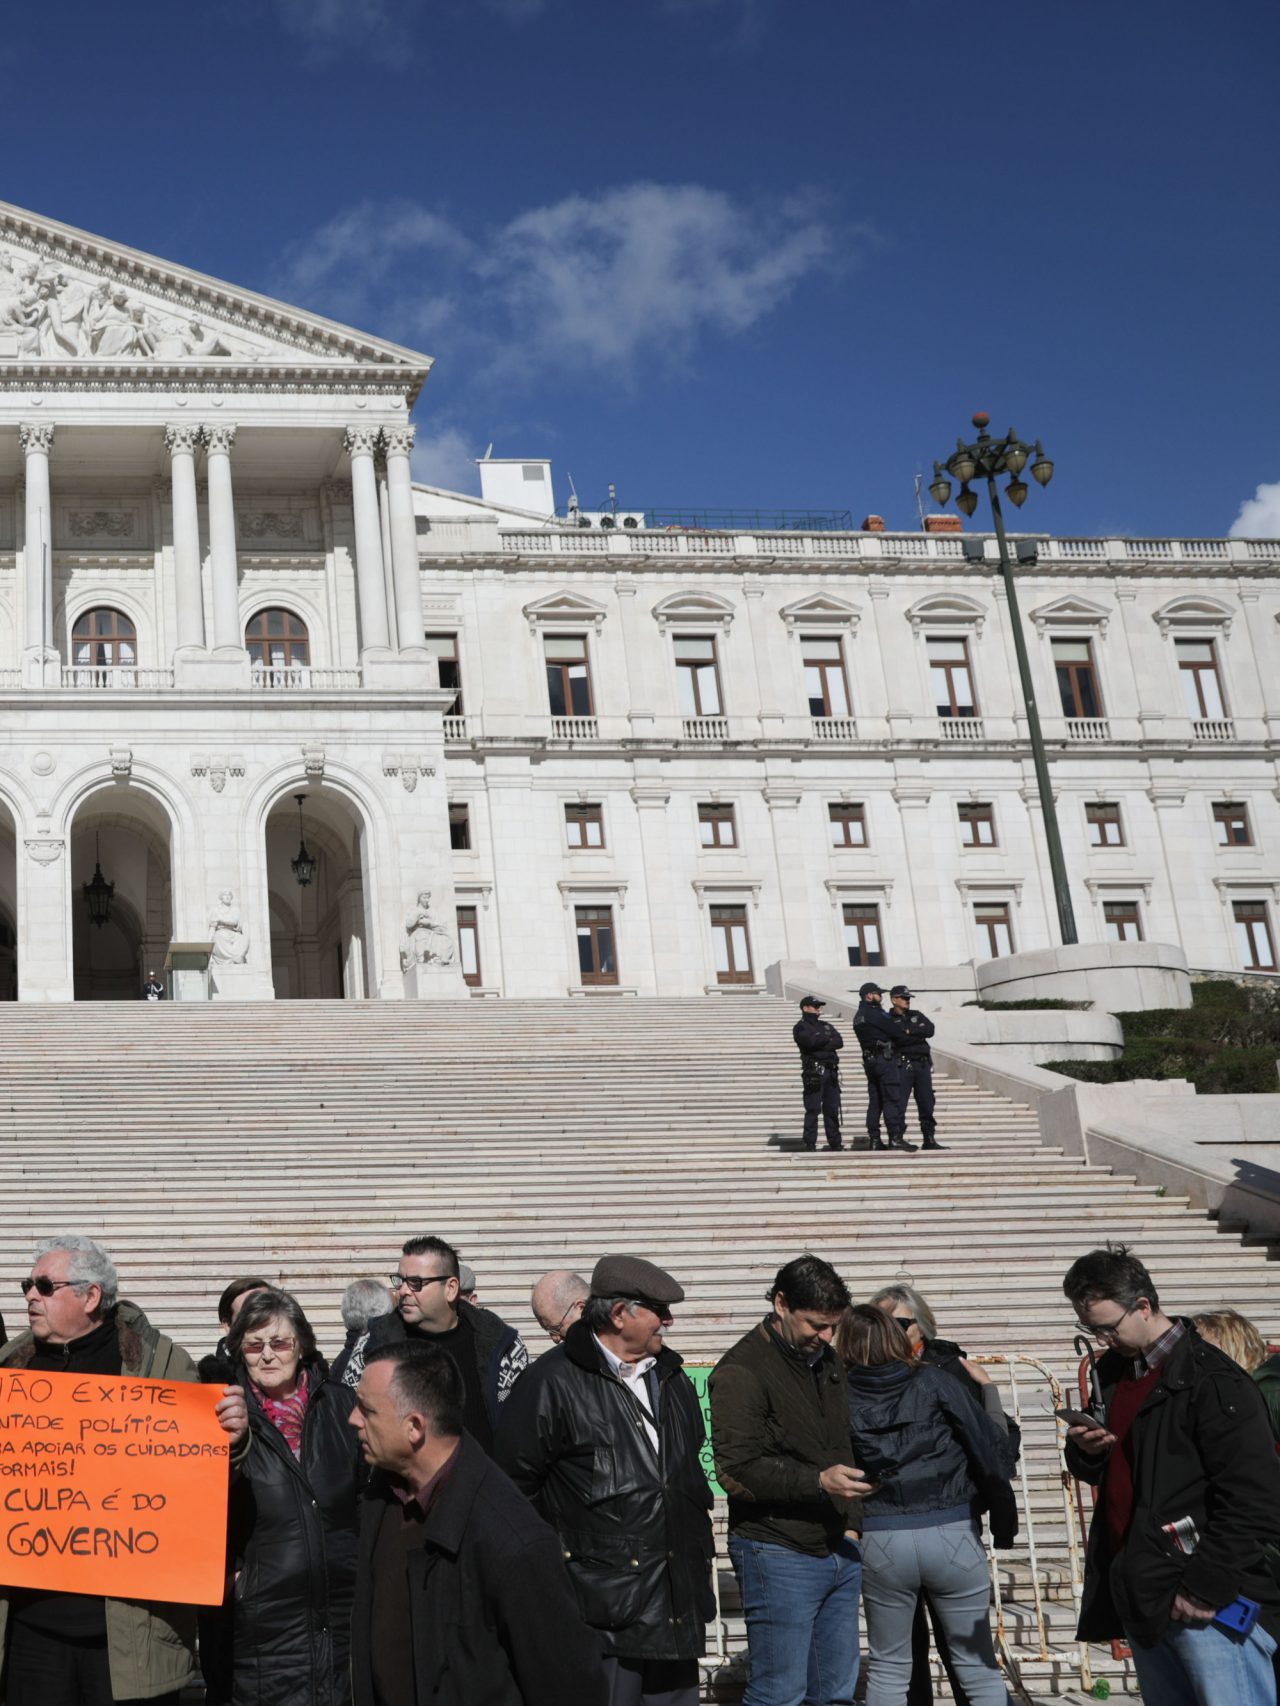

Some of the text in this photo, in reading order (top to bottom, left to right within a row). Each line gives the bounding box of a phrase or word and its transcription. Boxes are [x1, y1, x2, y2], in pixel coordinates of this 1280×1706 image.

[93, 1442, 117, 1456] OS
[4, 1487, 91, 1512] CULPA
[101, 1487, 123, 1511] É
[132, 1493, 167, 1511] DO
[6, 1521, 160, 1559] GOVERNO
